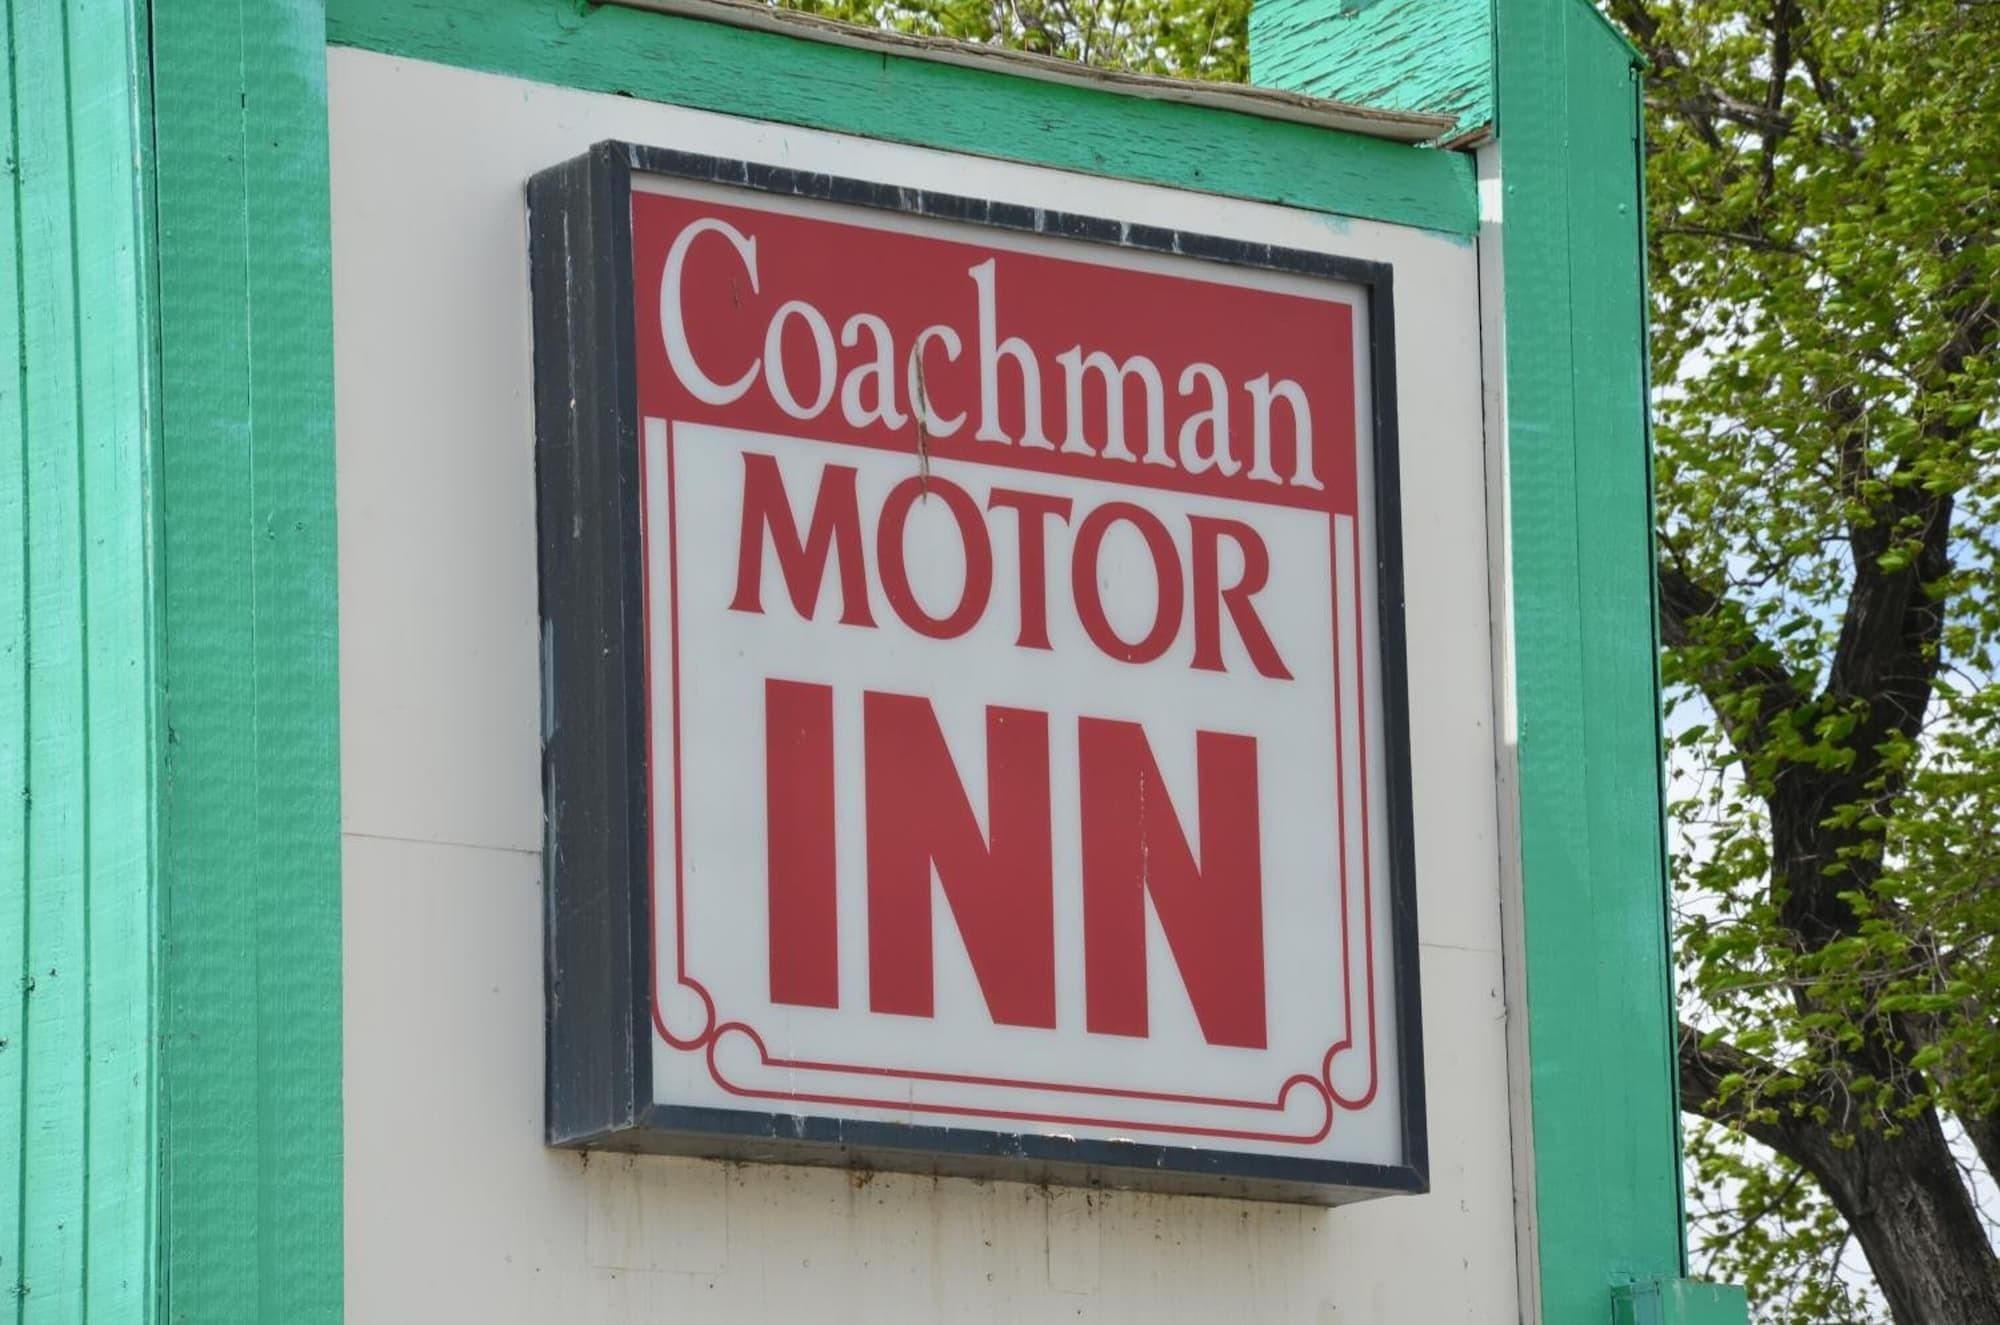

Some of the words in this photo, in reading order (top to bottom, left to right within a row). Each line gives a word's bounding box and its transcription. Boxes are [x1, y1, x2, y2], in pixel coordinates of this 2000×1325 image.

[659, 217, 1325, 491] Coachman
[729, 452, 1294, 681] MOTOR
[765, 677, 1268, 1050] INN
